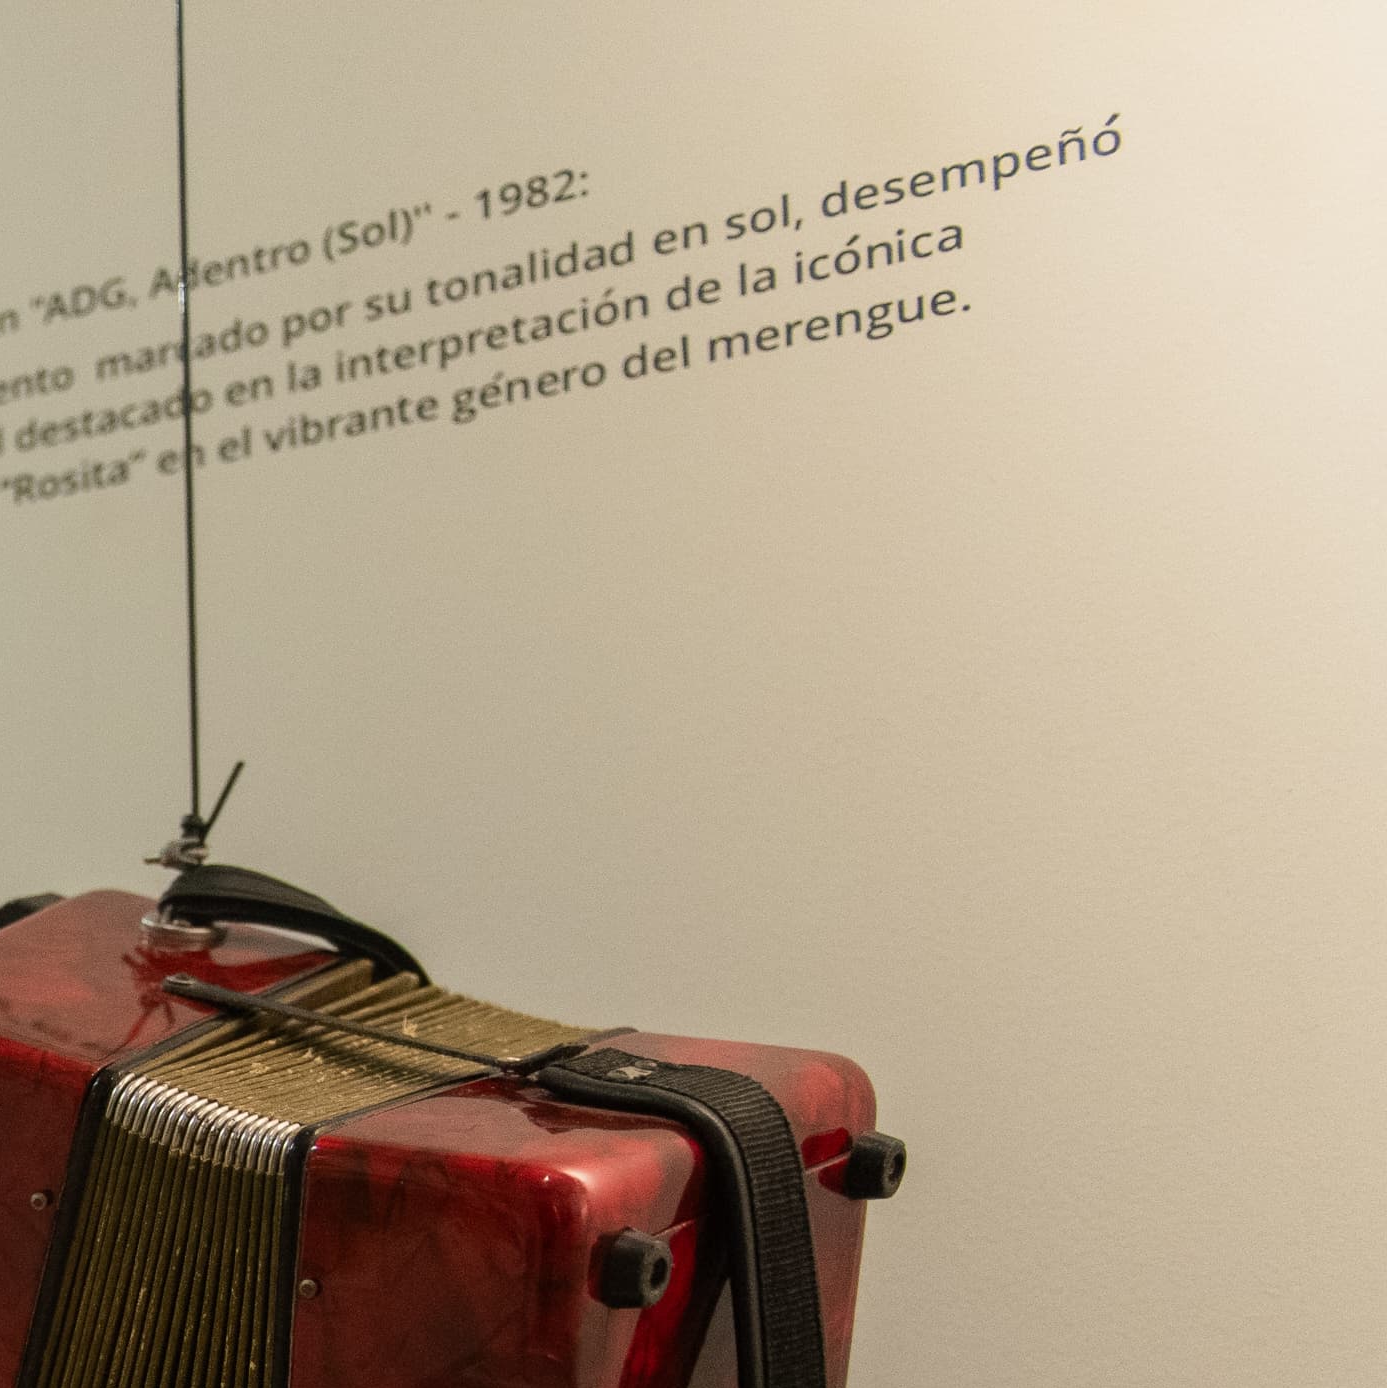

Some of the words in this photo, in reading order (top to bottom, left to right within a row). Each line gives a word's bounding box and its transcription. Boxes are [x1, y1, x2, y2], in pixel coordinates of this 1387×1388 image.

[148, 239, 310, 299] Adentro
[475, 167, 589, 221] 1982:
[282, 302, 351, 347] por
[365, 288, 412, 323] su
[426, 231, 635, 307] tonalidad
[653, 219, 709, 256] en
[725, 193, 805, 243] sol,
[821, 113, 1123, 218] desempeñó
[14, 386, 213, 453] destacado
[224, 375, 275, 407] en
[288, 360, 323, 393] la
[335, 287, 650, 384] interpretación
[666, 276, 722, 314] de
[739, 262, 777, 299] la
[795, 223, 964, 285] icónica
[156, 442, 206, 477] en
[217, 424, 252, 463] el
[264, 395, 439, 453] vibrante
[452, 356, 606, 425] género
[623, 335, 690, 380] del
[708, 288, 972, 363] merengue.
